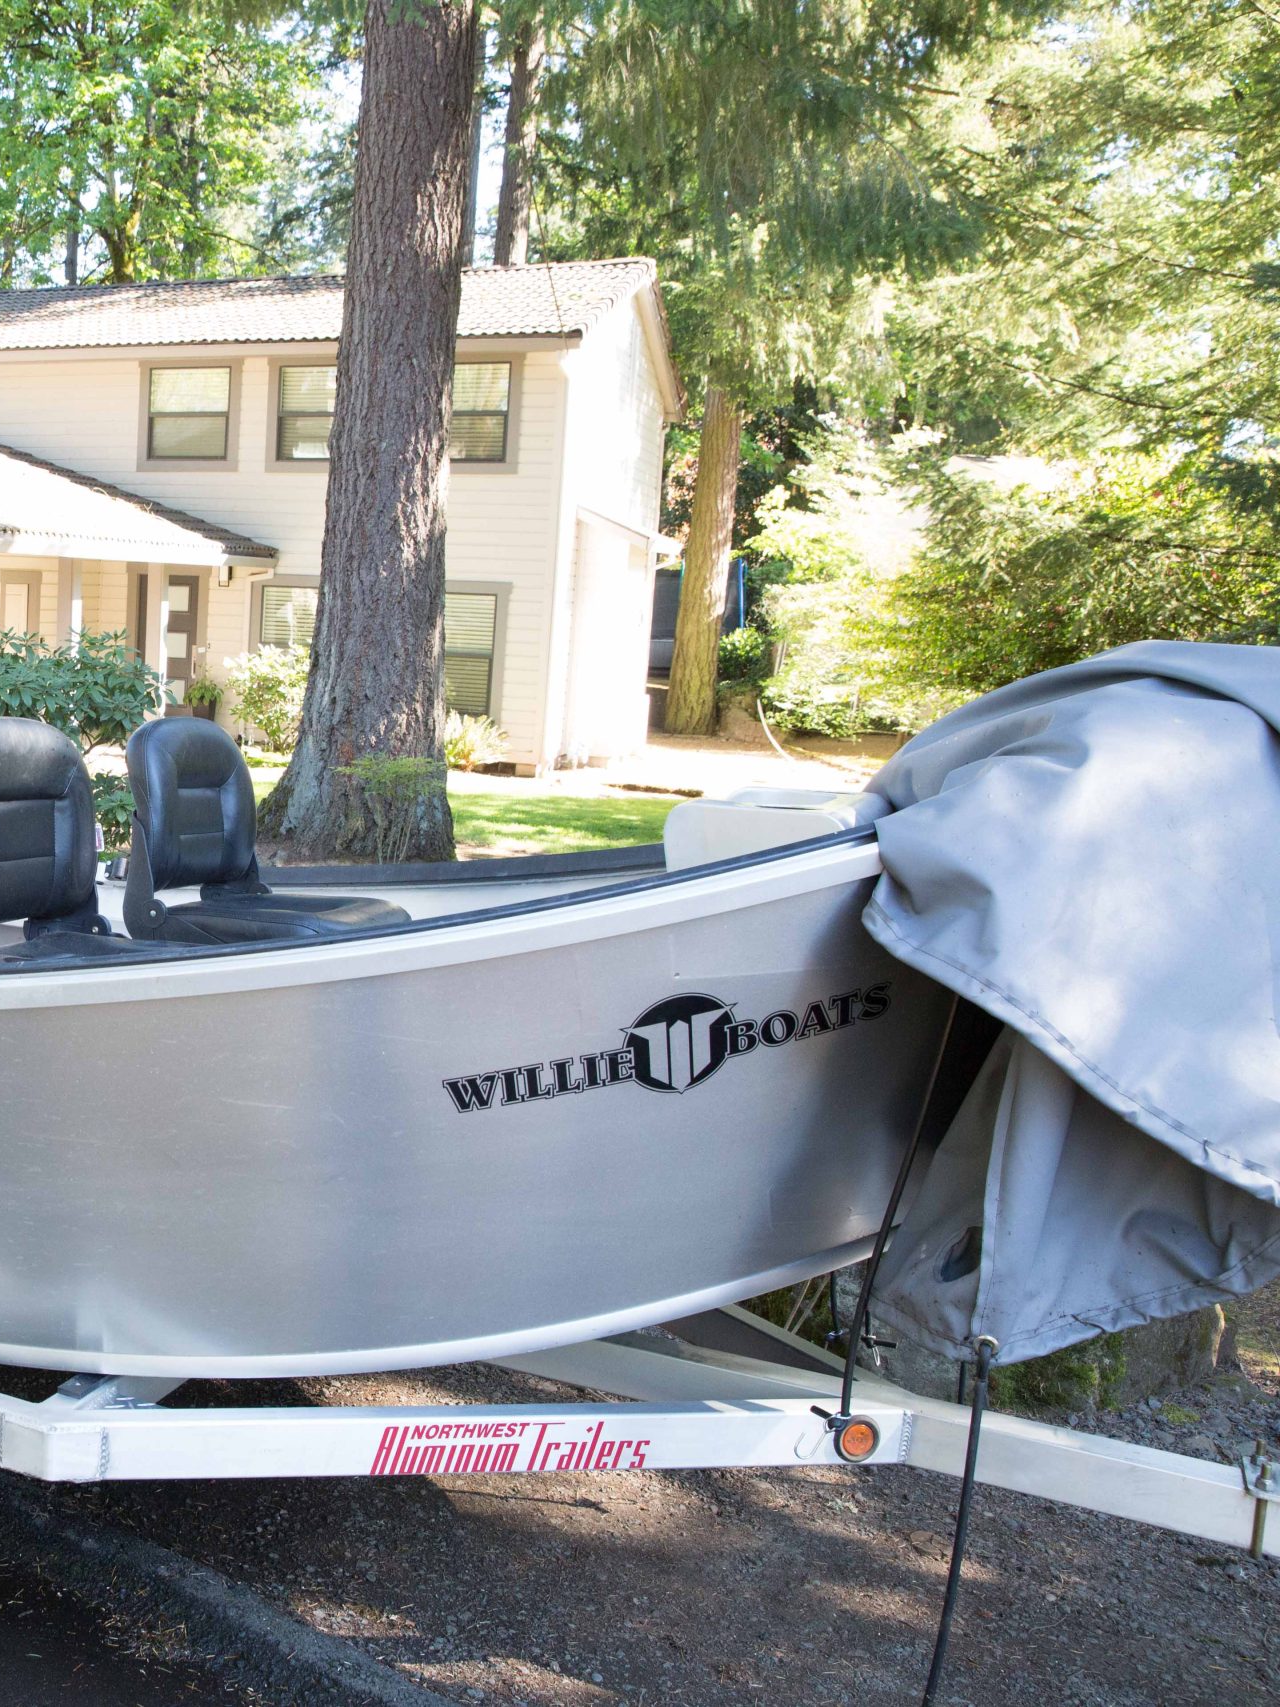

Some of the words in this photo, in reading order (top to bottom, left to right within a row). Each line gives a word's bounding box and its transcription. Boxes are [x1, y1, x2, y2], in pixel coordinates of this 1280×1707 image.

[442, 1048, 636, 1113] WILLIE
[724, 982, 892, 1059] BOATS
[369, 1426, 520, 1476] Aluminum
[526, 1421, 651, 1472] Trailers
[410, 1423, 531, 1440] NORTHWEST
